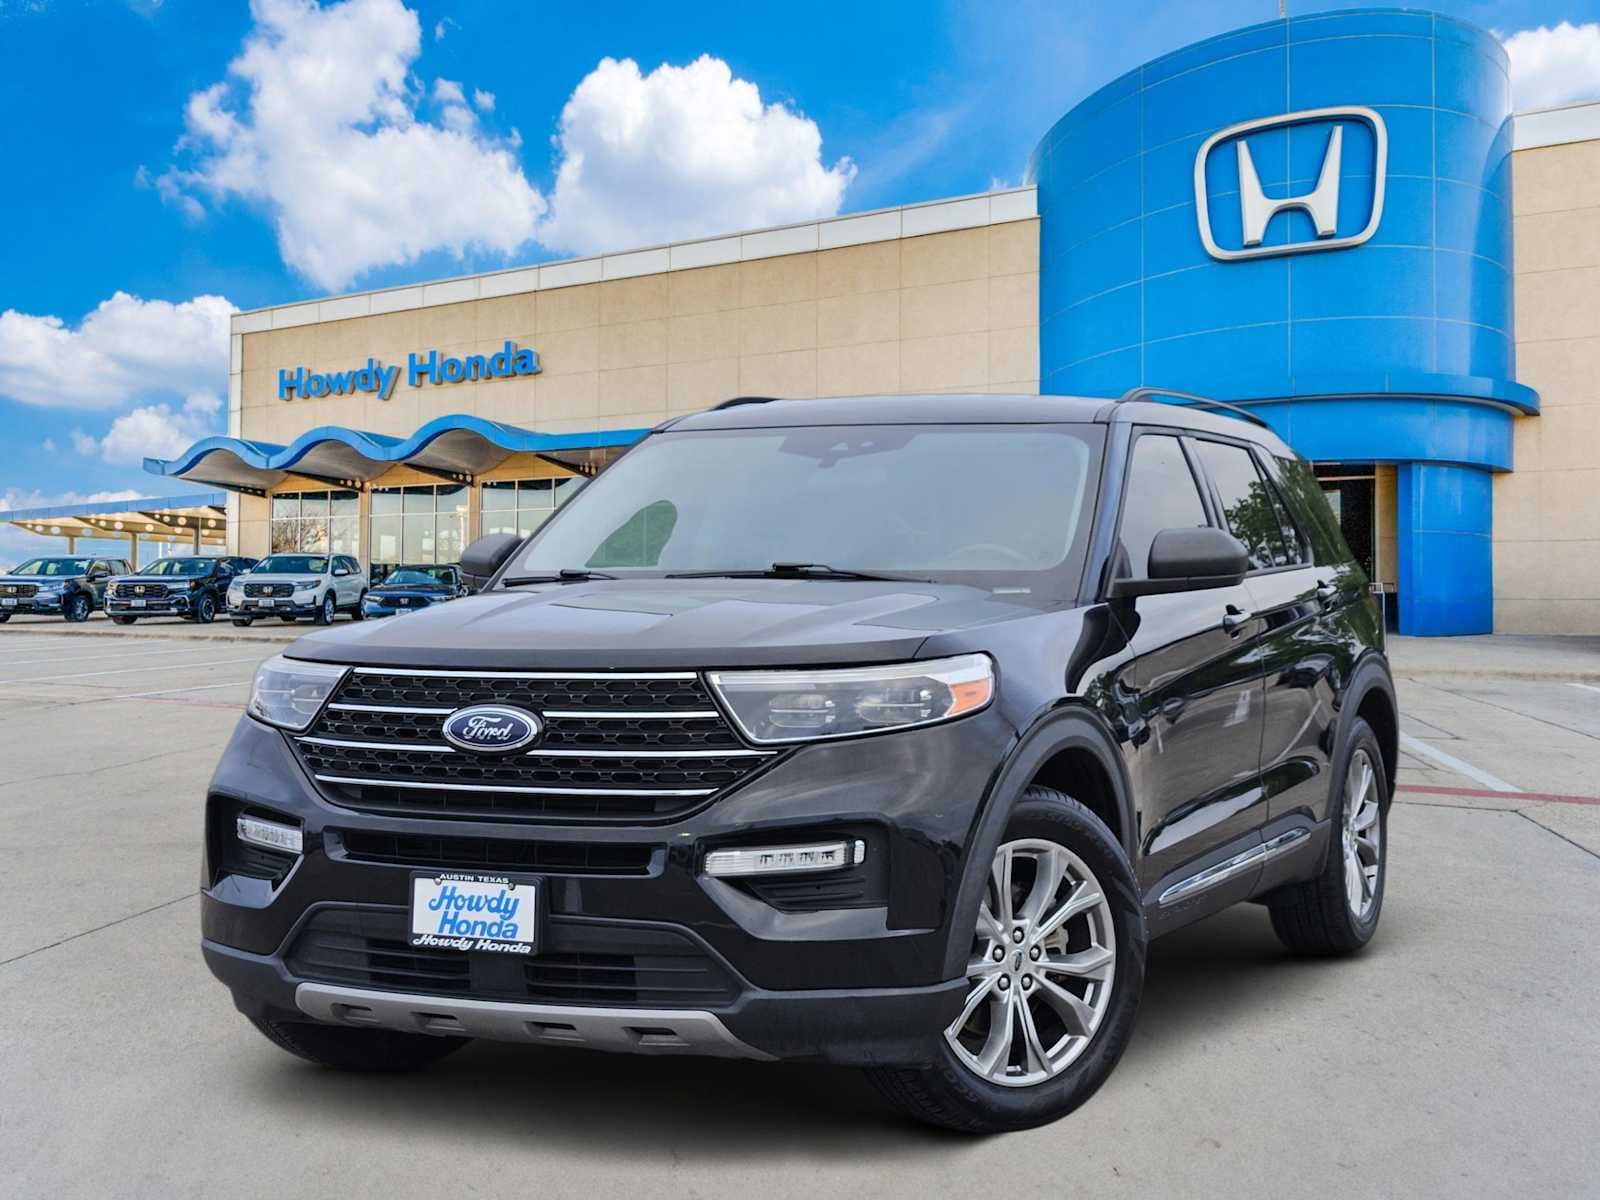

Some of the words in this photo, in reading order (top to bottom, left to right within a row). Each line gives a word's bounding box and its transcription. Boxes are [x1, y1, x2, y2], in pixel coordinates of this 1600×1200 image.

[278, 357, 401, 401] Howdy
[408, 340, 542, 388] Honda
[463, 715, 514, 740] Ford
[440, 873, 475, 881] AUSTIN
[477, 875, 509, 884] TEXAS
[428, 886, 520, 921] Howdy
[437, 911, 519, 939] Honda
[412, 934, 474, 951] Howdy
[475, 939, 531, 954] Honda
